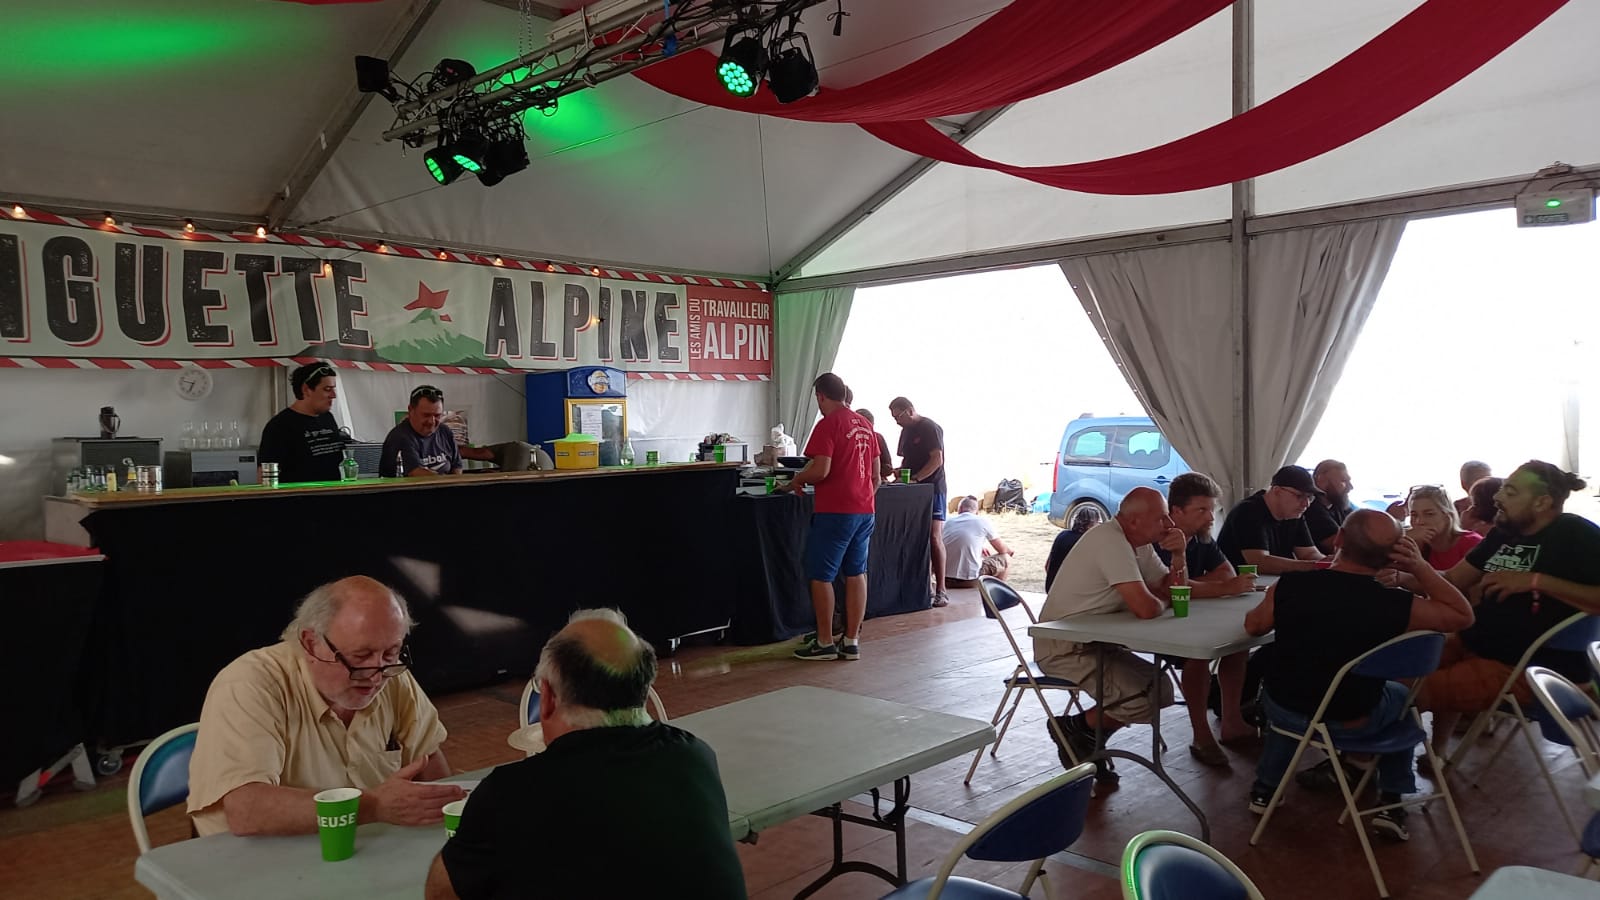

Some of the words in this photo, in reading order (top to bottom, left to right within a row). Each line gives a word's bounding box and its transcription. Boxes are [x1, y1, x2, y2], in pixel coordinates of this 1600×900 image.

[690, 298, 701, 312] DU
[702, 299, 770, 320] TRAVAILLEUR
[485, 277, 683, 363] ALPINE
[690, 315, 701, 339] AMIS
[690, 342, 702, 360] LES
[703, 322, 770, 361] ALPIN
